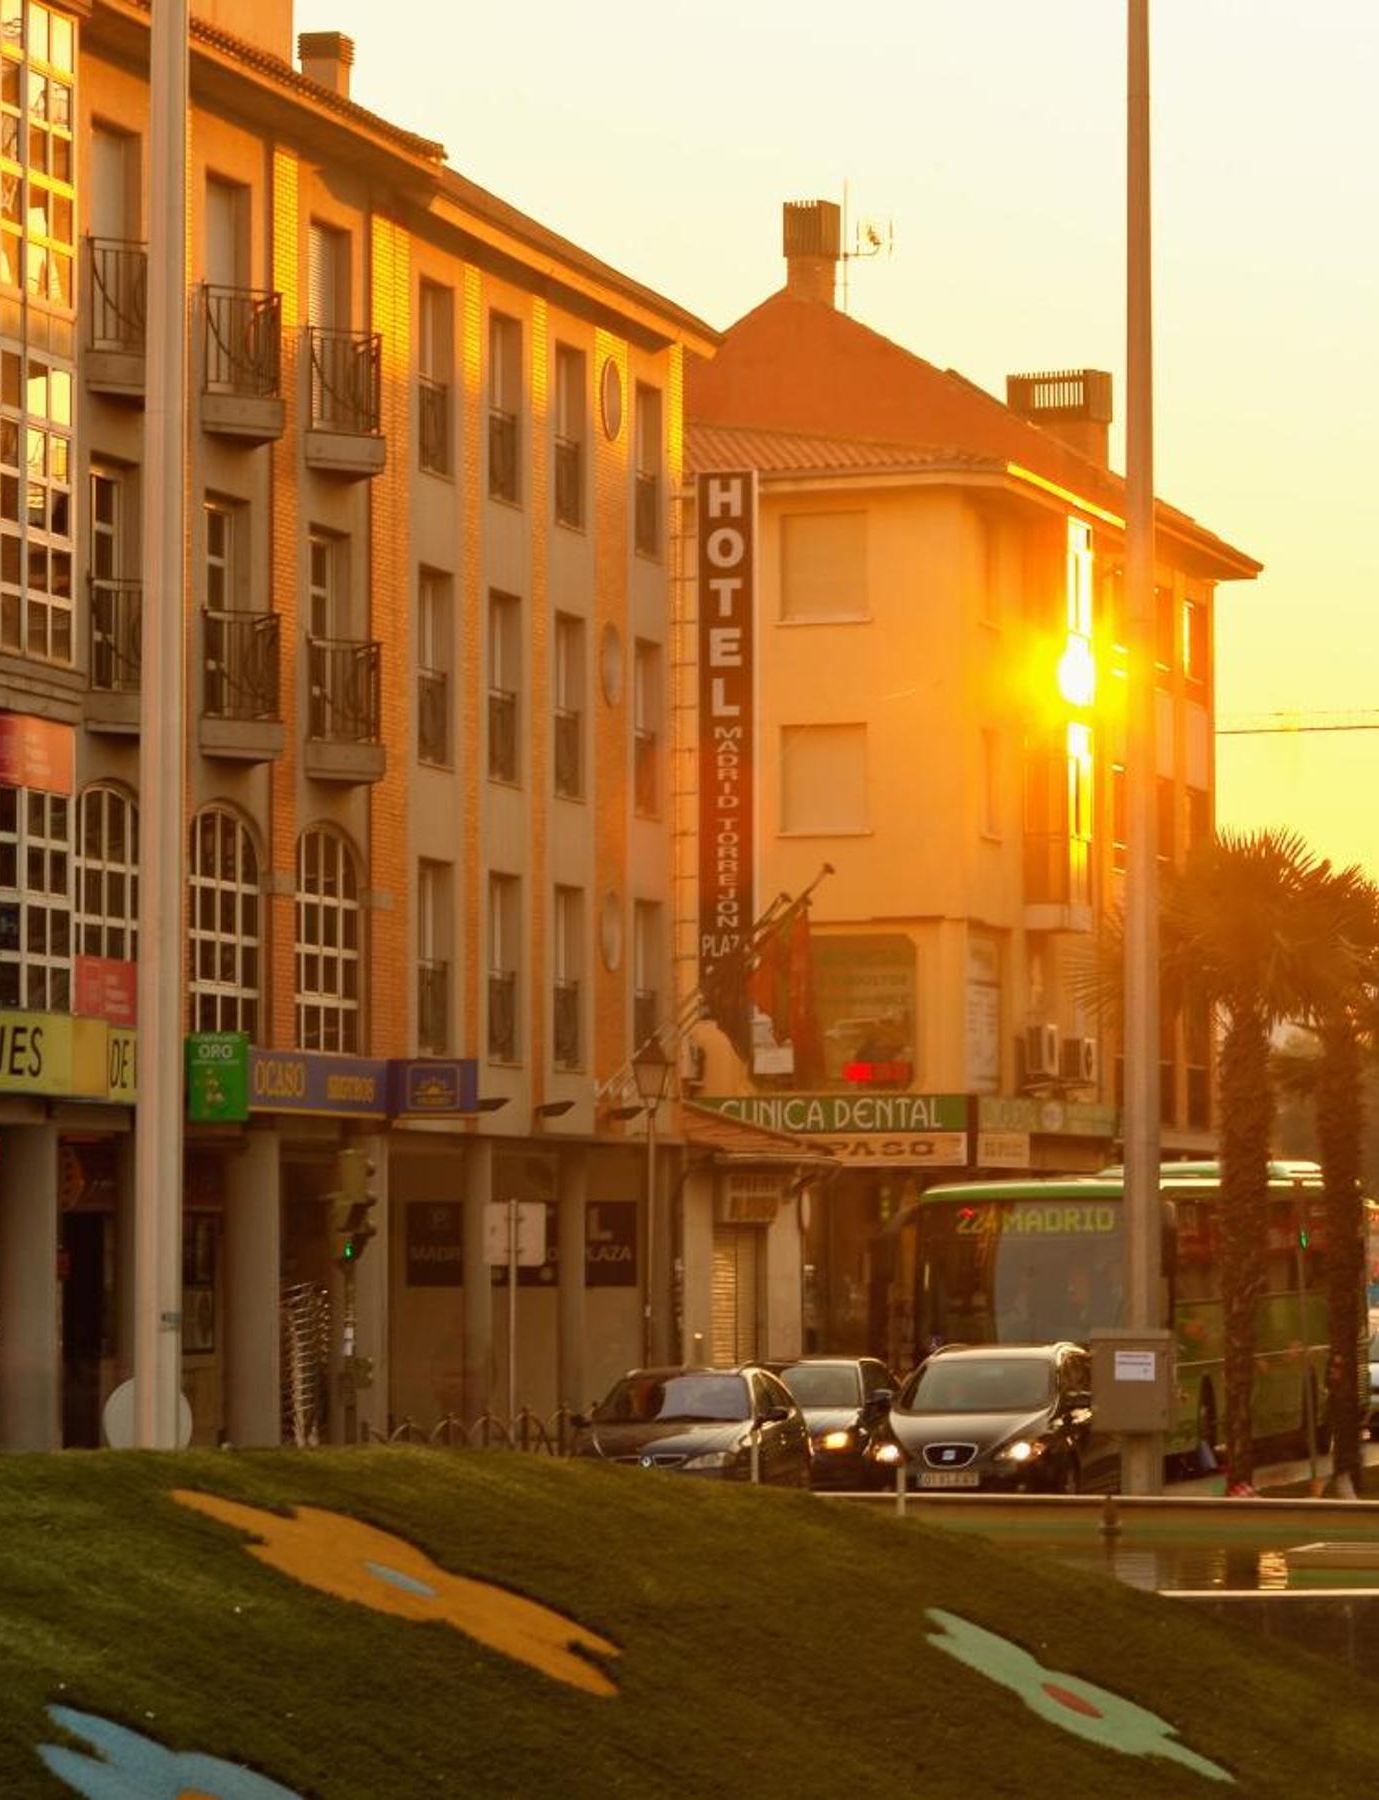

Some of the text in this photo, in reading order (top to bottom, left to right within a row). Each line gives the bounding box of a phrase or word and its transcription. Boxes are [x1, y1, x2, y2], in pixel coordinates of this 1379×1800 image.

[706, 478, 744, 717] HOTEL
[198, 1043, 234, 1059] ORO
[834, 1096, 942, 1129] DENTAL
[1002, 1206, 1116, 1233] MADRID
